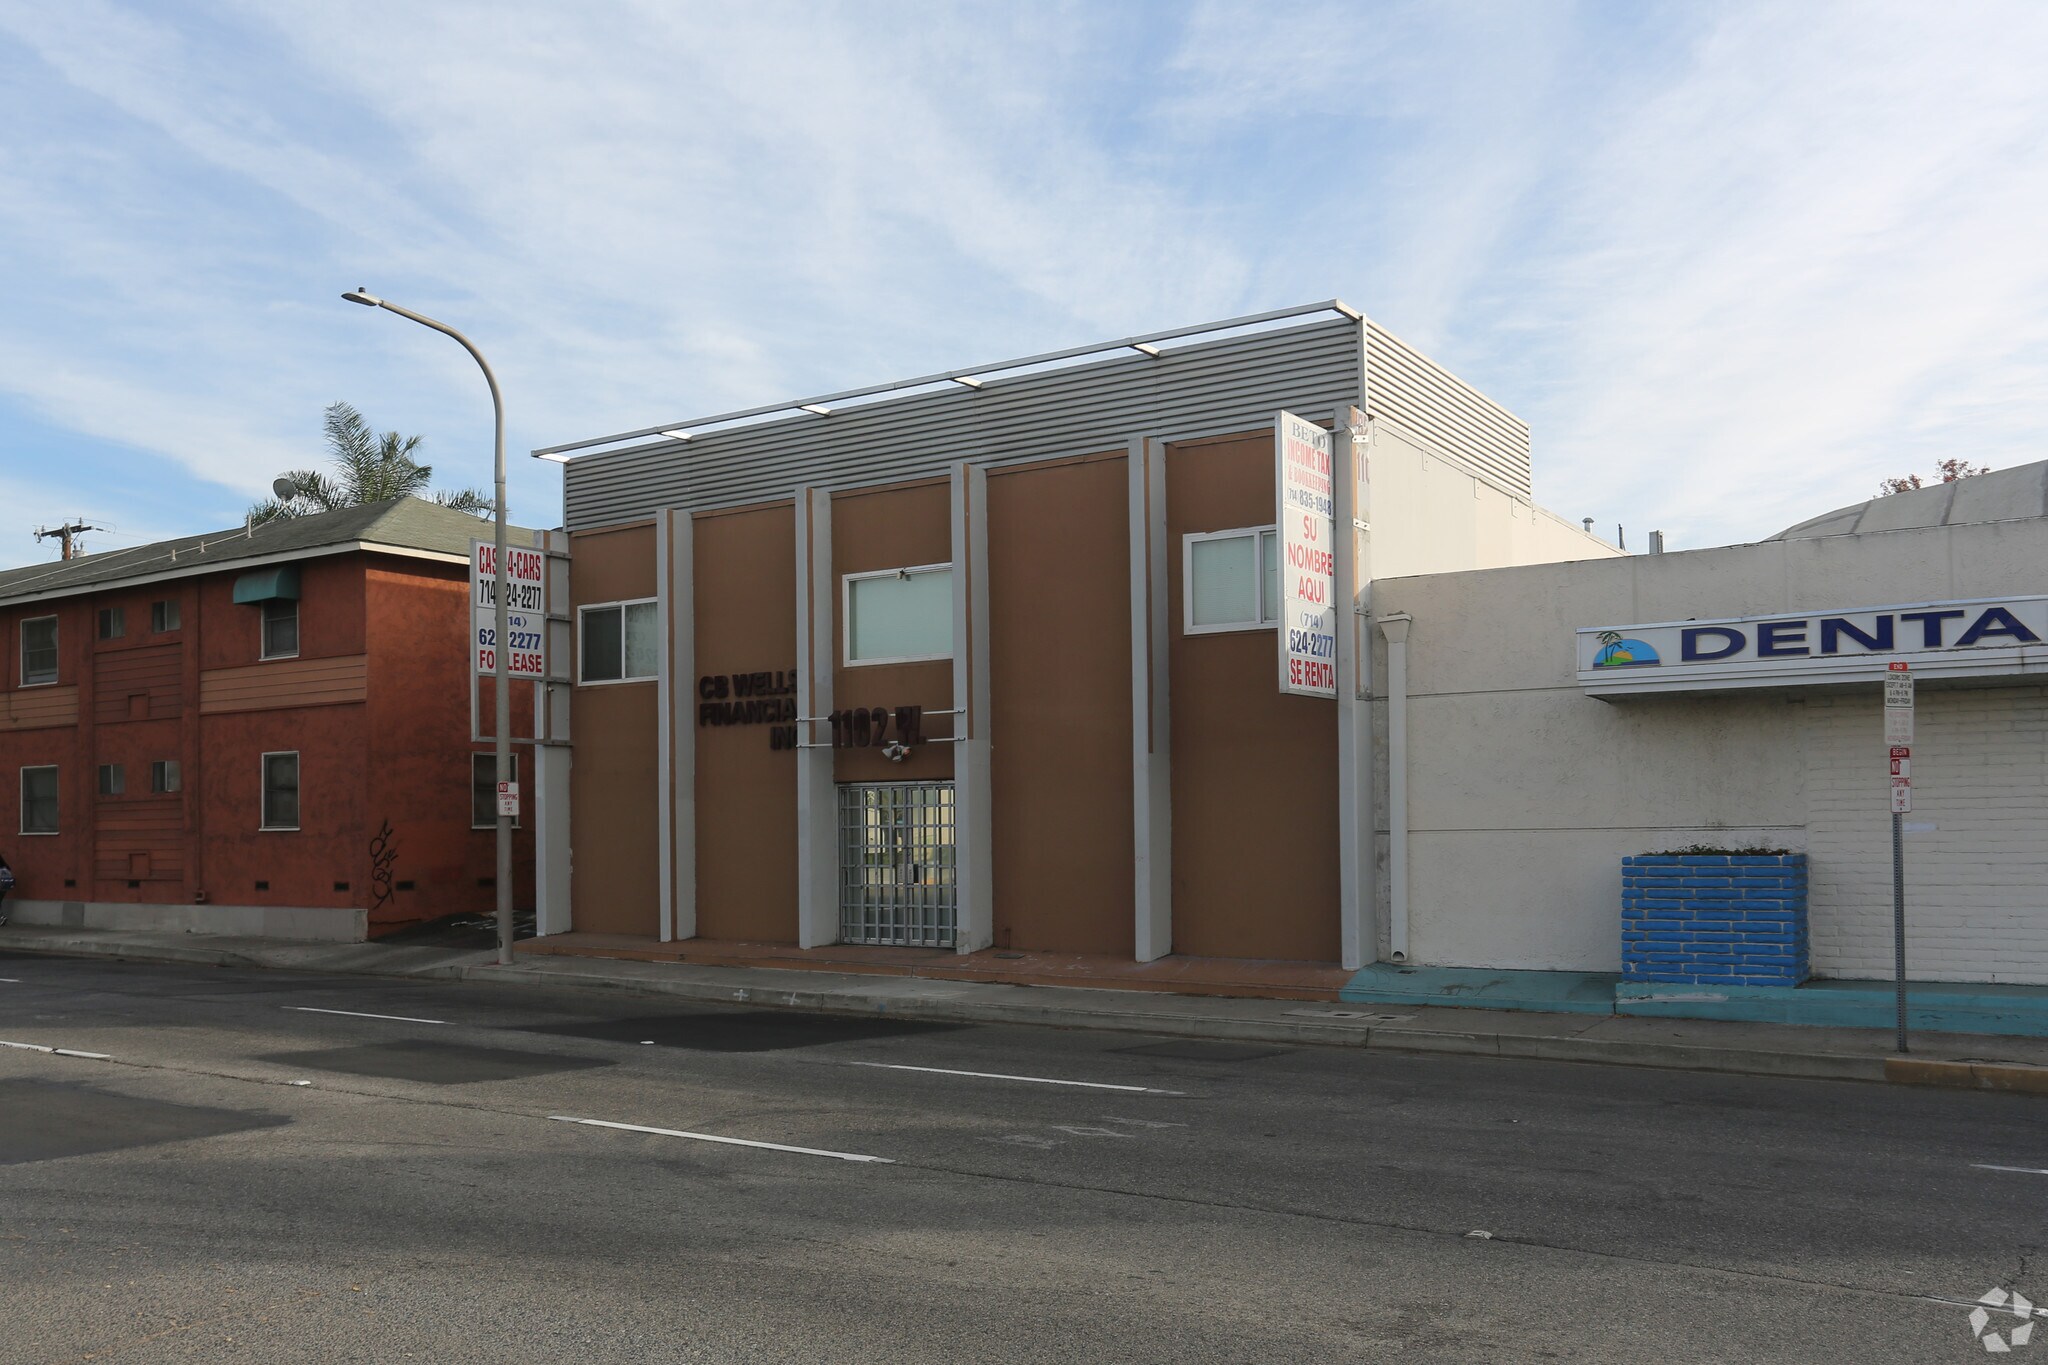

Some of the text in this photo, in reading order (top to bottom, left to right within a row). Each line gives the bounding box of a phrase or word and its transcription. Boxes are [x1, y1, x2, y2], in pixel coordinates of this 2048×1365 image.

[1292, 422, 1326, 449] BETO
[1288, 437, 1316, 470] INCOME
[1316, 450, 1331, 477] TAX
[1303, 515, 1317, 541] SU
[1288, 541, 1333, 577] NOMBRE
[1298, 575, 1325, 604] AQUI
[1300, 610, 1324, 631] (714)
[1681, 606, 2042, 662] DENTA
[1290, 628, 1334, 659] 624-2277
[699, 668, 797, 700] CB WELLS
[1290, 658, 1335, 690] SE RENTA
[699, 697, 797, 728] FINANCIA
[828, 707, 888, 750] 1102
[1892, 760, 1899, 773] NO
[499, 783, 507, 792] NO
[1892, 777, 1910, 788] STOPPING
[1896, 799, 1905, 807] TIME
